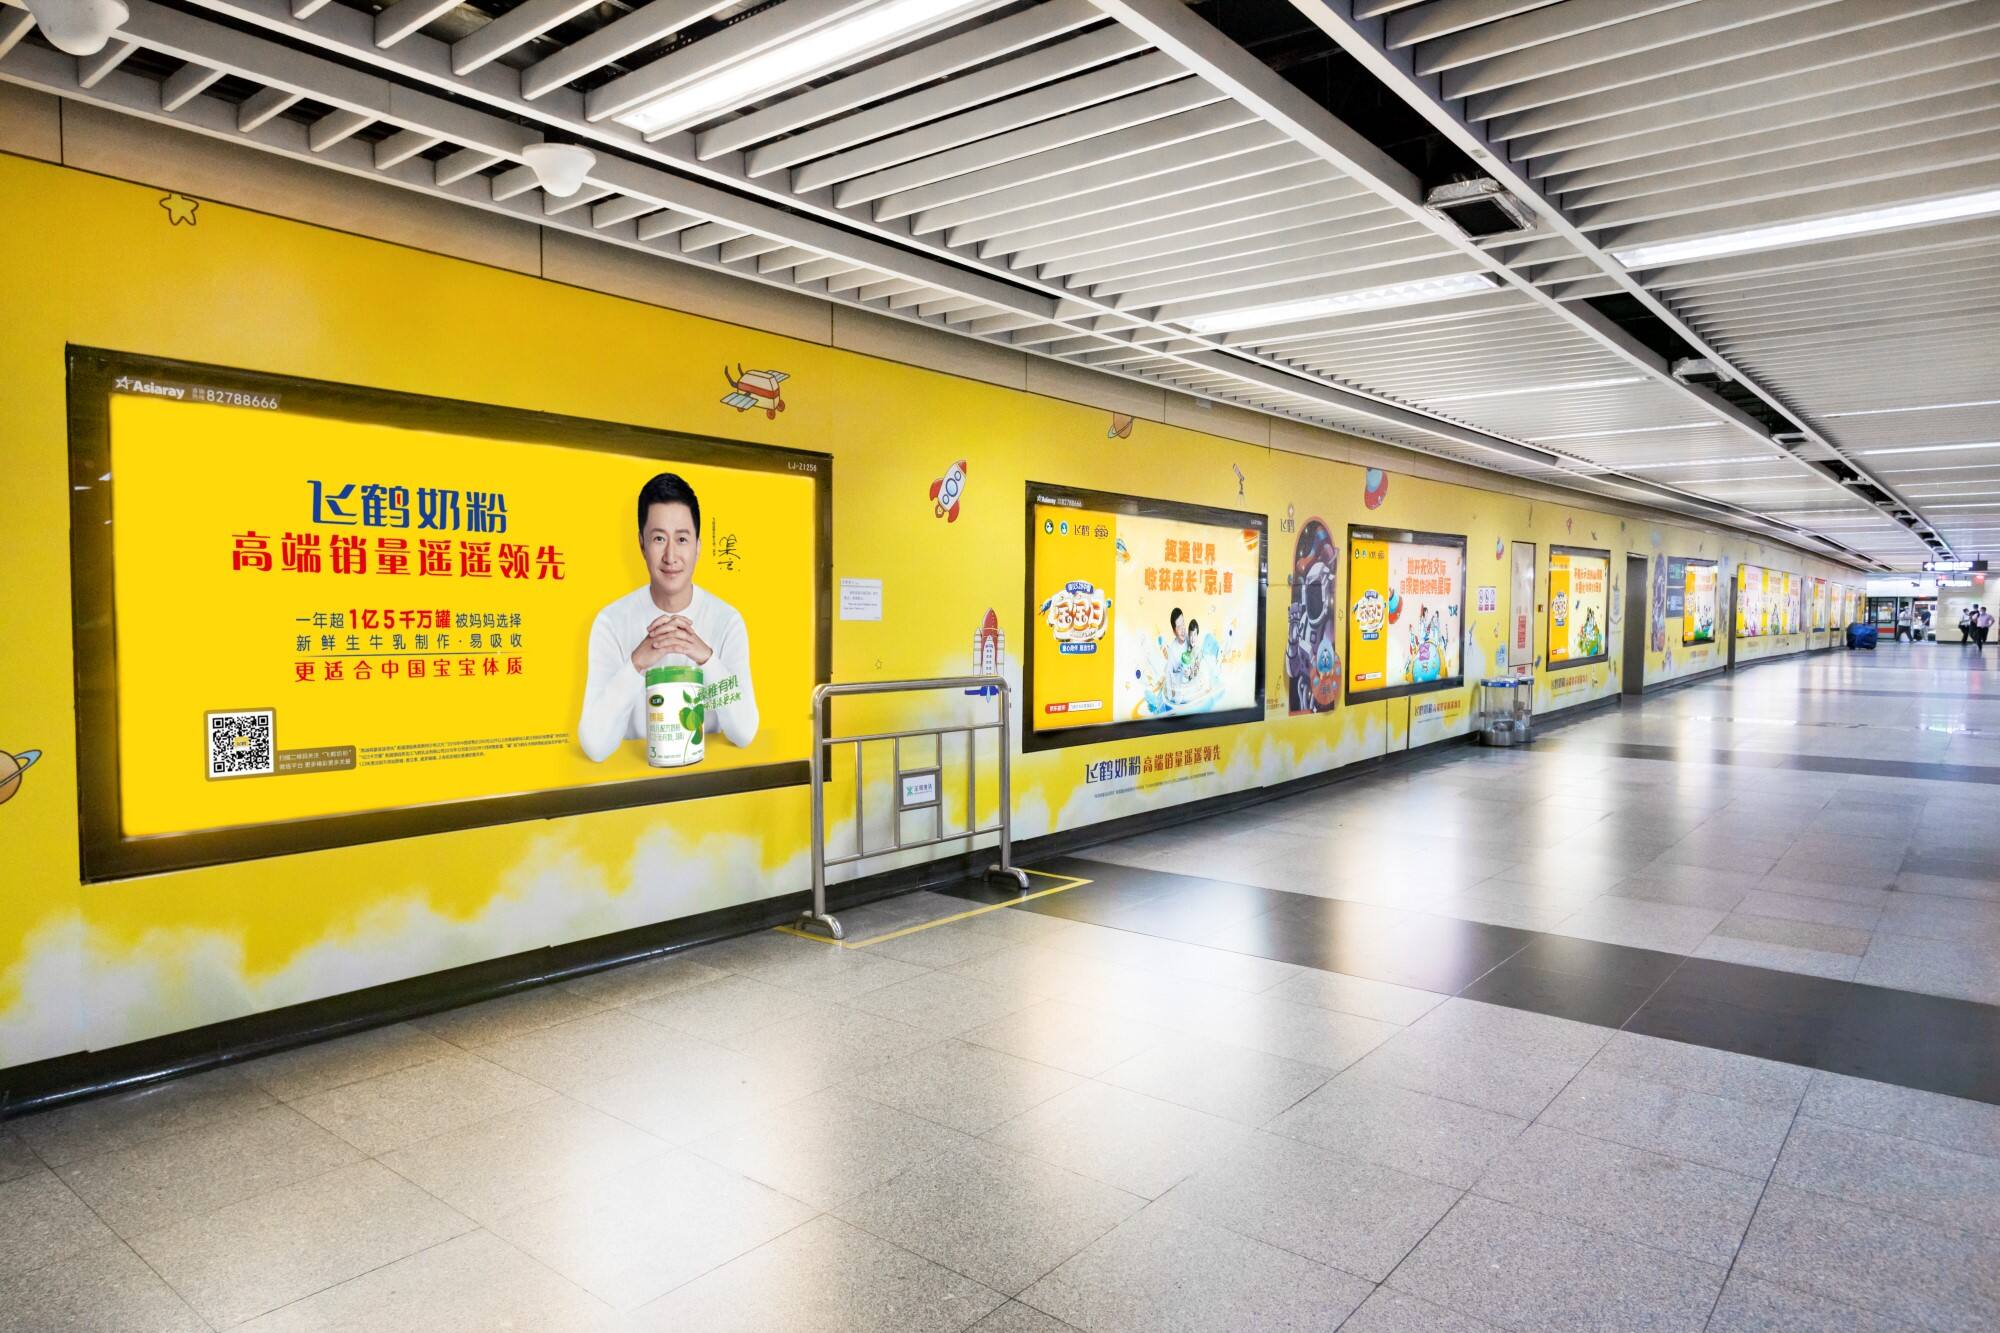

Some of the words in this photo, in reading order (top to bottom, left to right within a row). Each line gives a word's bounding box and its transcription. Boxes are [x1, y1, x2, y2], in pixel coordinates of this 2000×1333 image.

[133, 380, 185, 399] Asiaray
[206, 390, 278, 409] 82788666
[306, 480, 508, 533] 飞鹤奶粉
[231, 530, 566, 580] 高端销量遥遥领先
[295, 657, 523, 683] 更适合中国宝宝体质
[1086, 754, 1141, 783] 飞鹤奶粉
